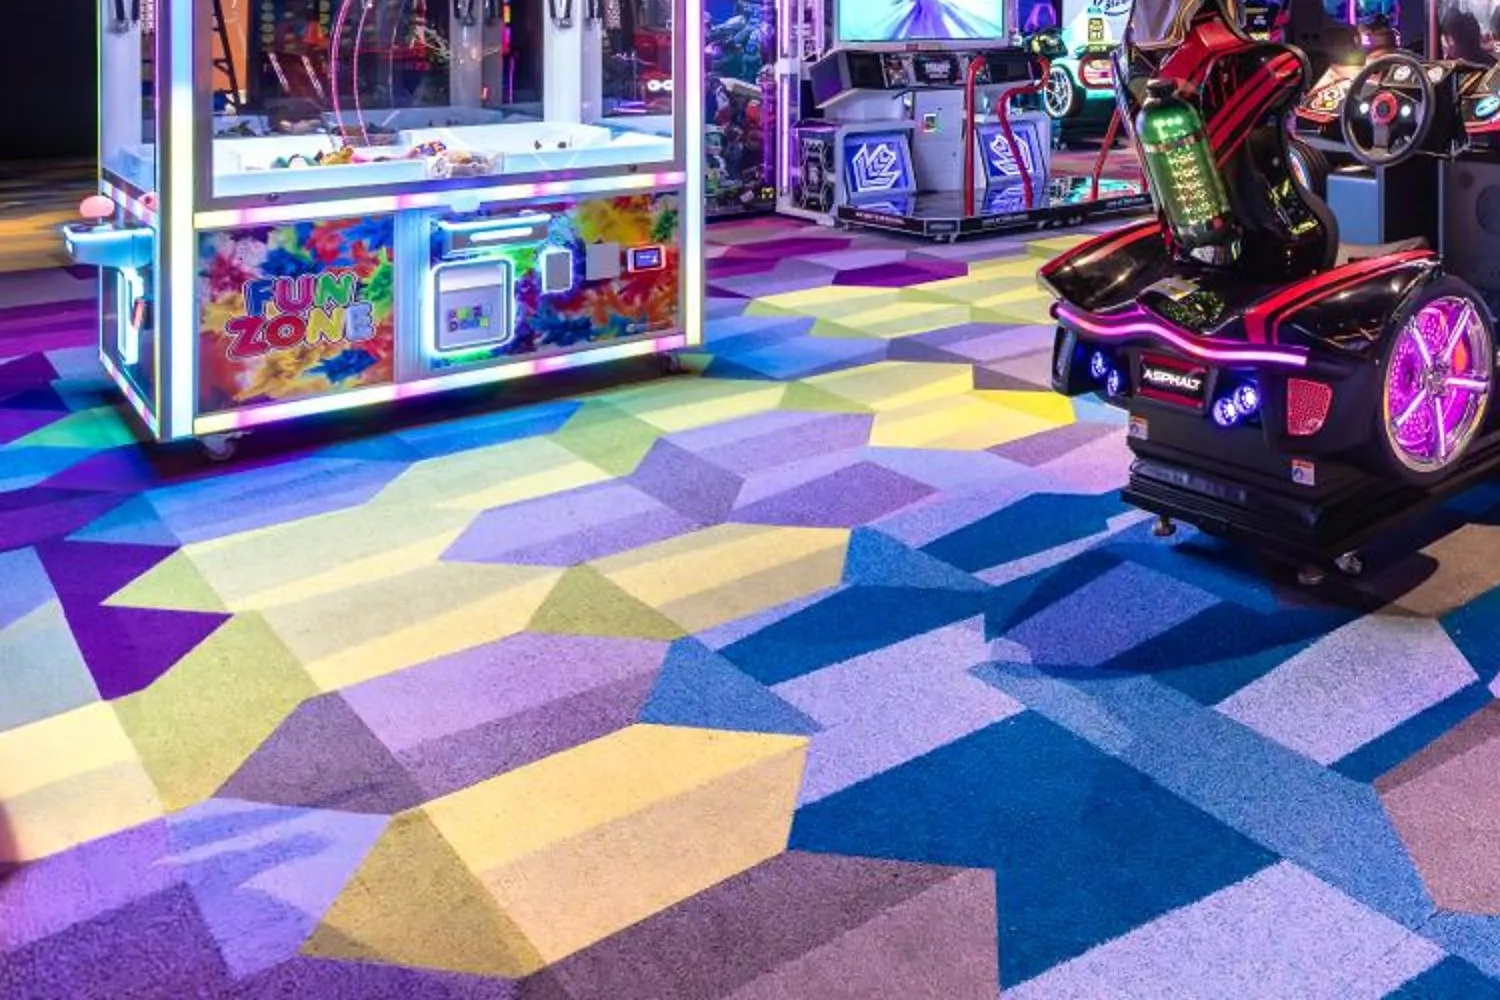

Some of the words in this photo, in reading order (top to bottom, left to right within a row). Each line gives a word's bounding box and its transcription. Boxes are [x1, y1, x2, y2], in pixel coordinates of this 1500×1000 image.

[243, 273, 359, 318] FUN
[225, 301, 376, 360] ZONE
[1143, 368, 1202, 390] ASPHALT
